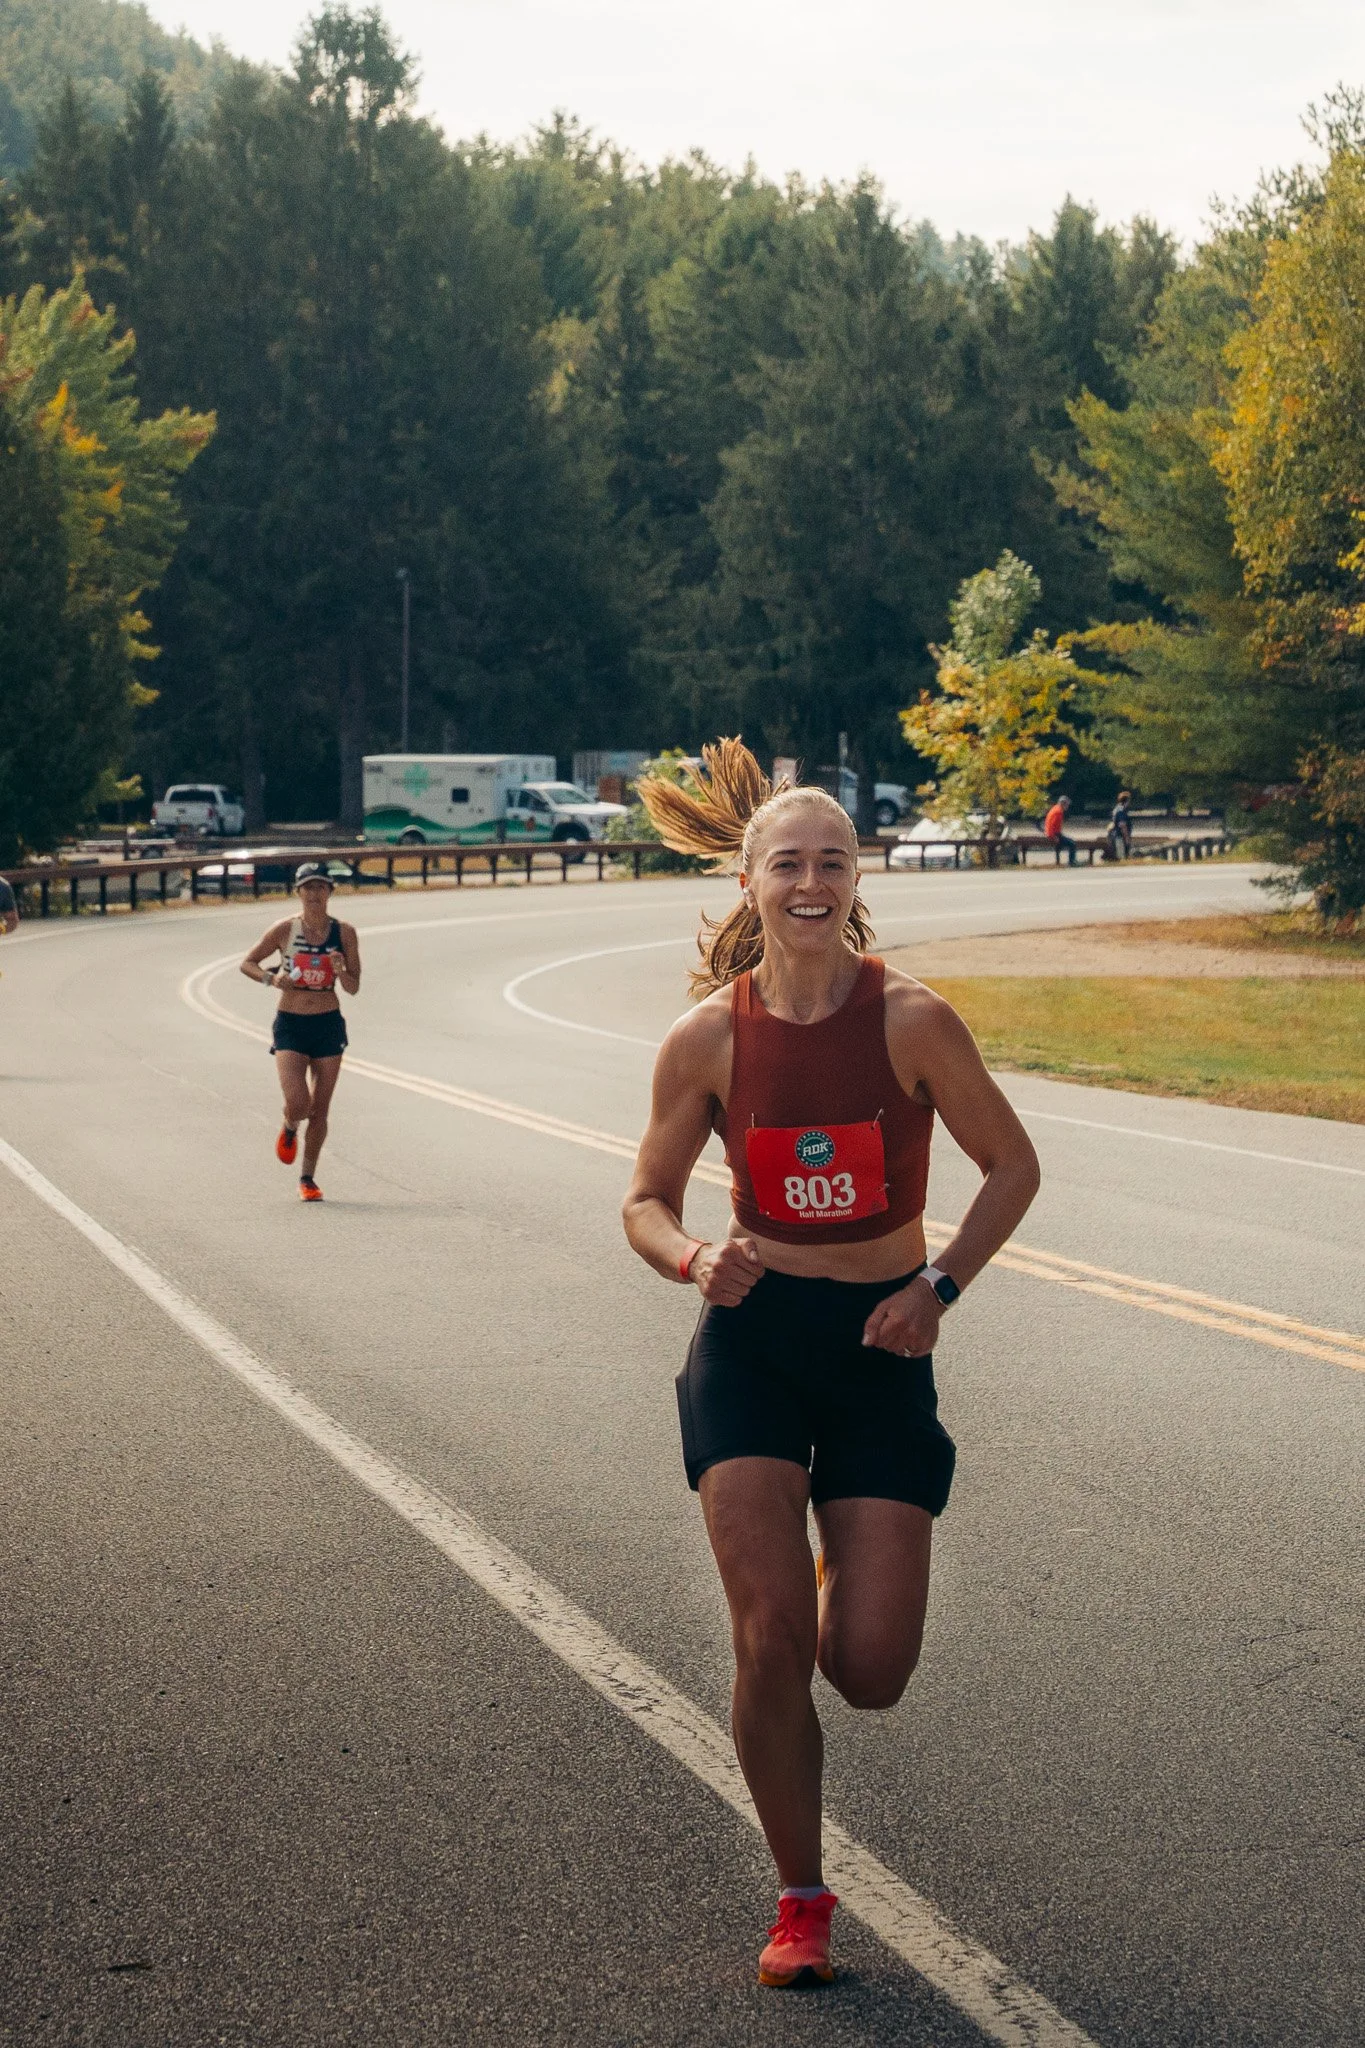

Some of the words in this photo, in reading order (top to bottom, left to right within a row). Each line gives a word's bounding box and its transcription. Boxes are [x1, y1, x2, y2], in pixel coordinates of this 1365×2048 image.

[802, 1141, 829, 1157] ADK
[784, 1172, 856, 1210] 803
[799, 1210, 815, 1218] Half
[816, 1208, 853, 1218] Marathon
